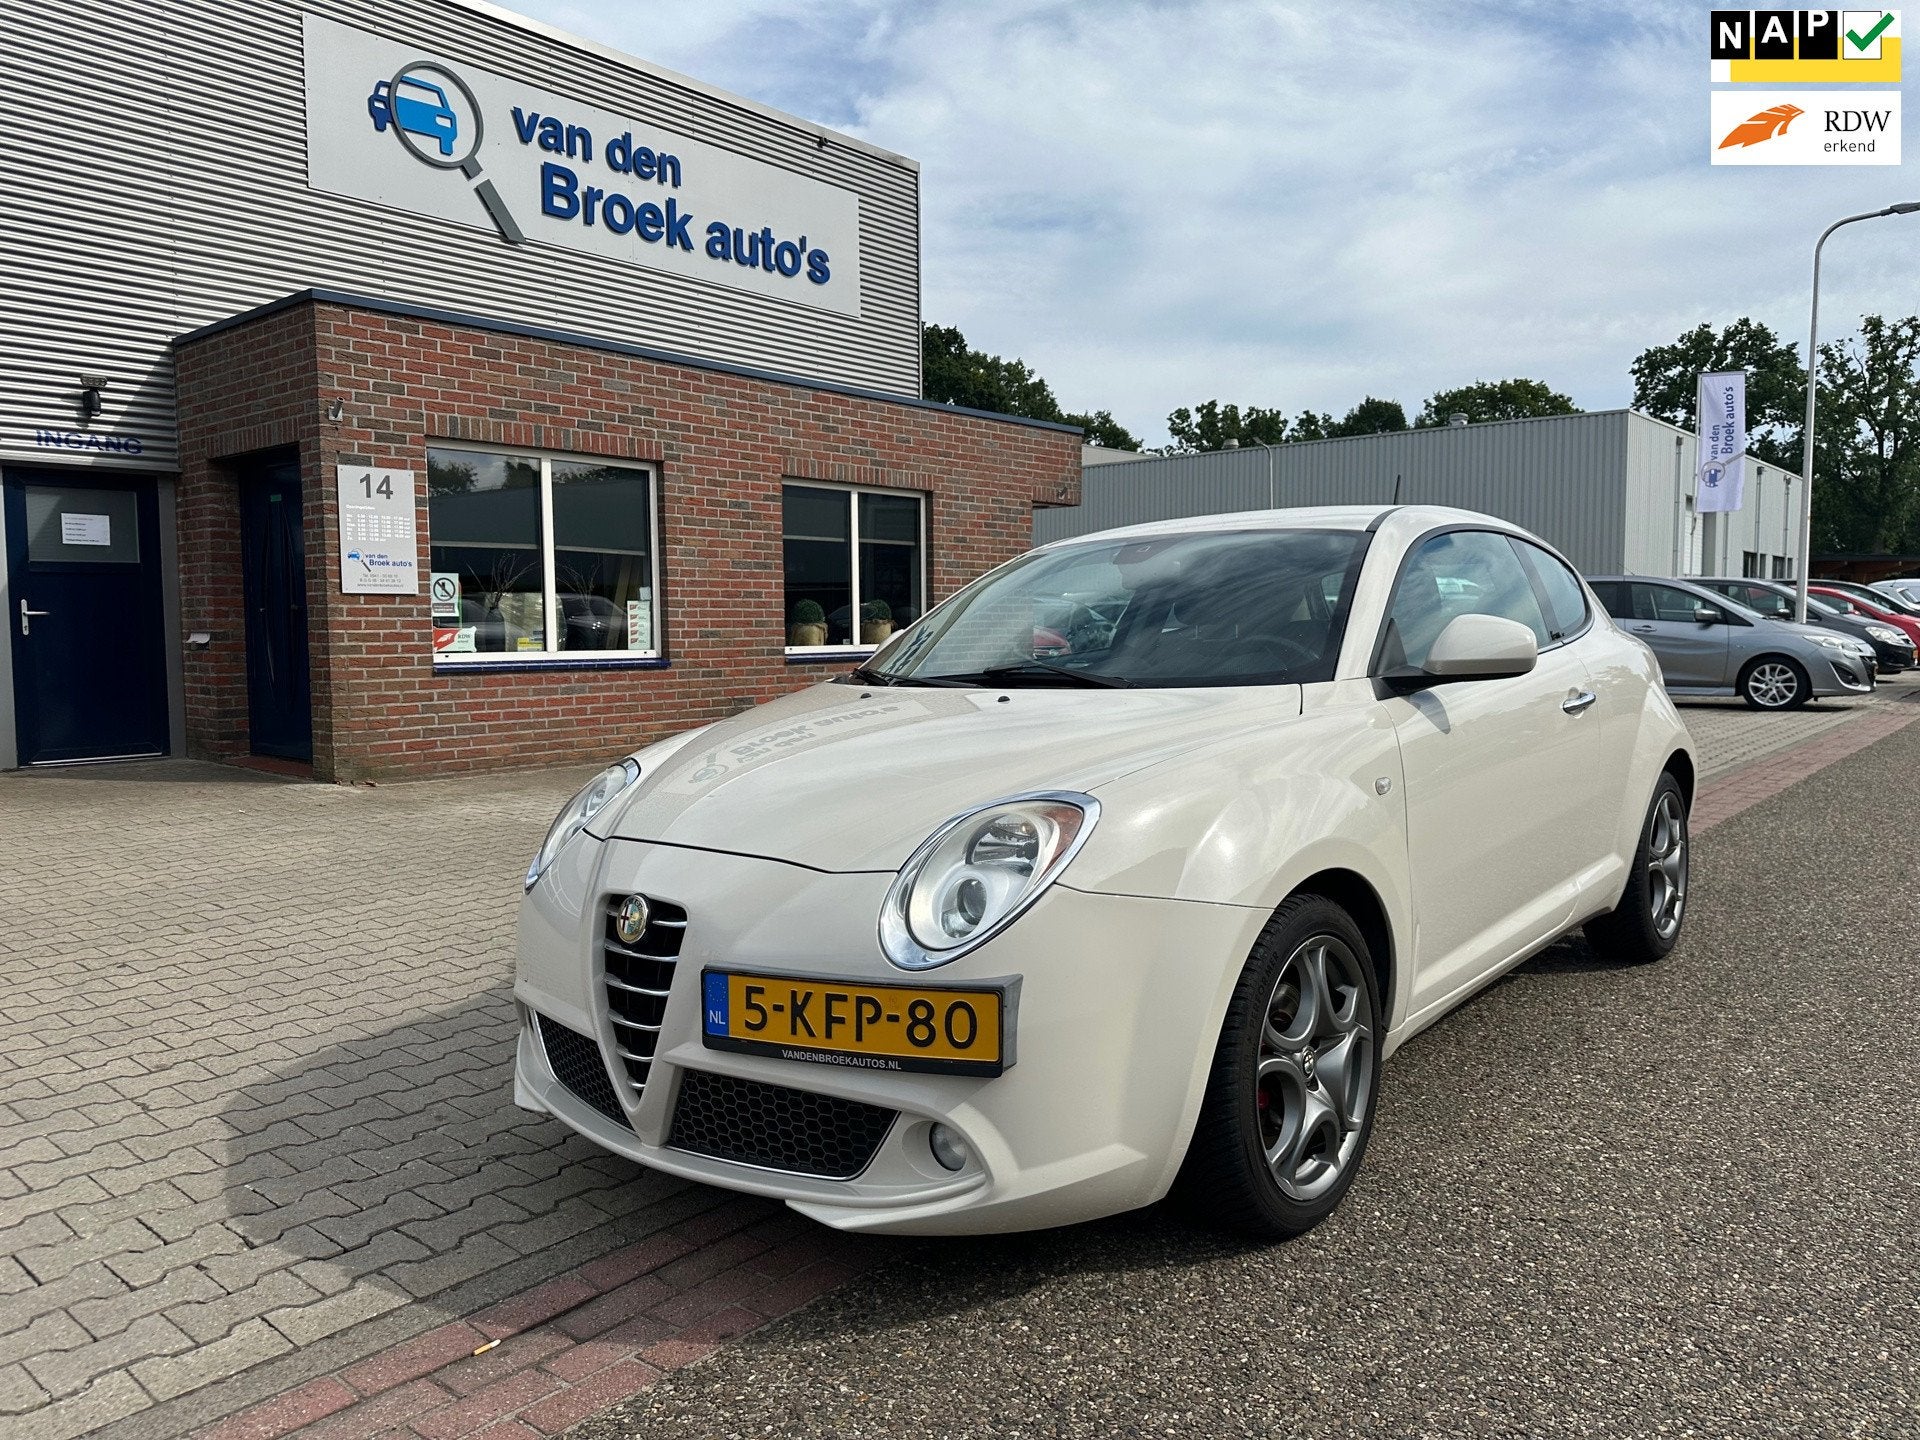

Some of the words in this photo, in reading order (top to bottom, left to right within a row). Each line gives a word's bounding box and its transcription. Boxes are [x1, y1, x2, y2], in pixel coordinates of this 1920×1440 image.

[511, 106, 592, 162] van
[605, 131, 682, 187] den
[540, 161, 694, 250] Broek
[705, 221, 831, 285] auto's
[1723, 386, 1735, 420] auto's
[36, 429, 143, 454] INGANG
[1709, 424, 1720, 443] den
[1721, 421, 1735, 454] Broek
[1711, 444, 1719, 461] van
[360, 473, 393, 499] 14
[369, 559, 390, 567] Broek
[709, 1009, 726, 1026] NL
[744, 984, 978, 1050] 5-KFP-80
[781, 1049, 902, 1071] VANDENBROEKAUTOS.NL
